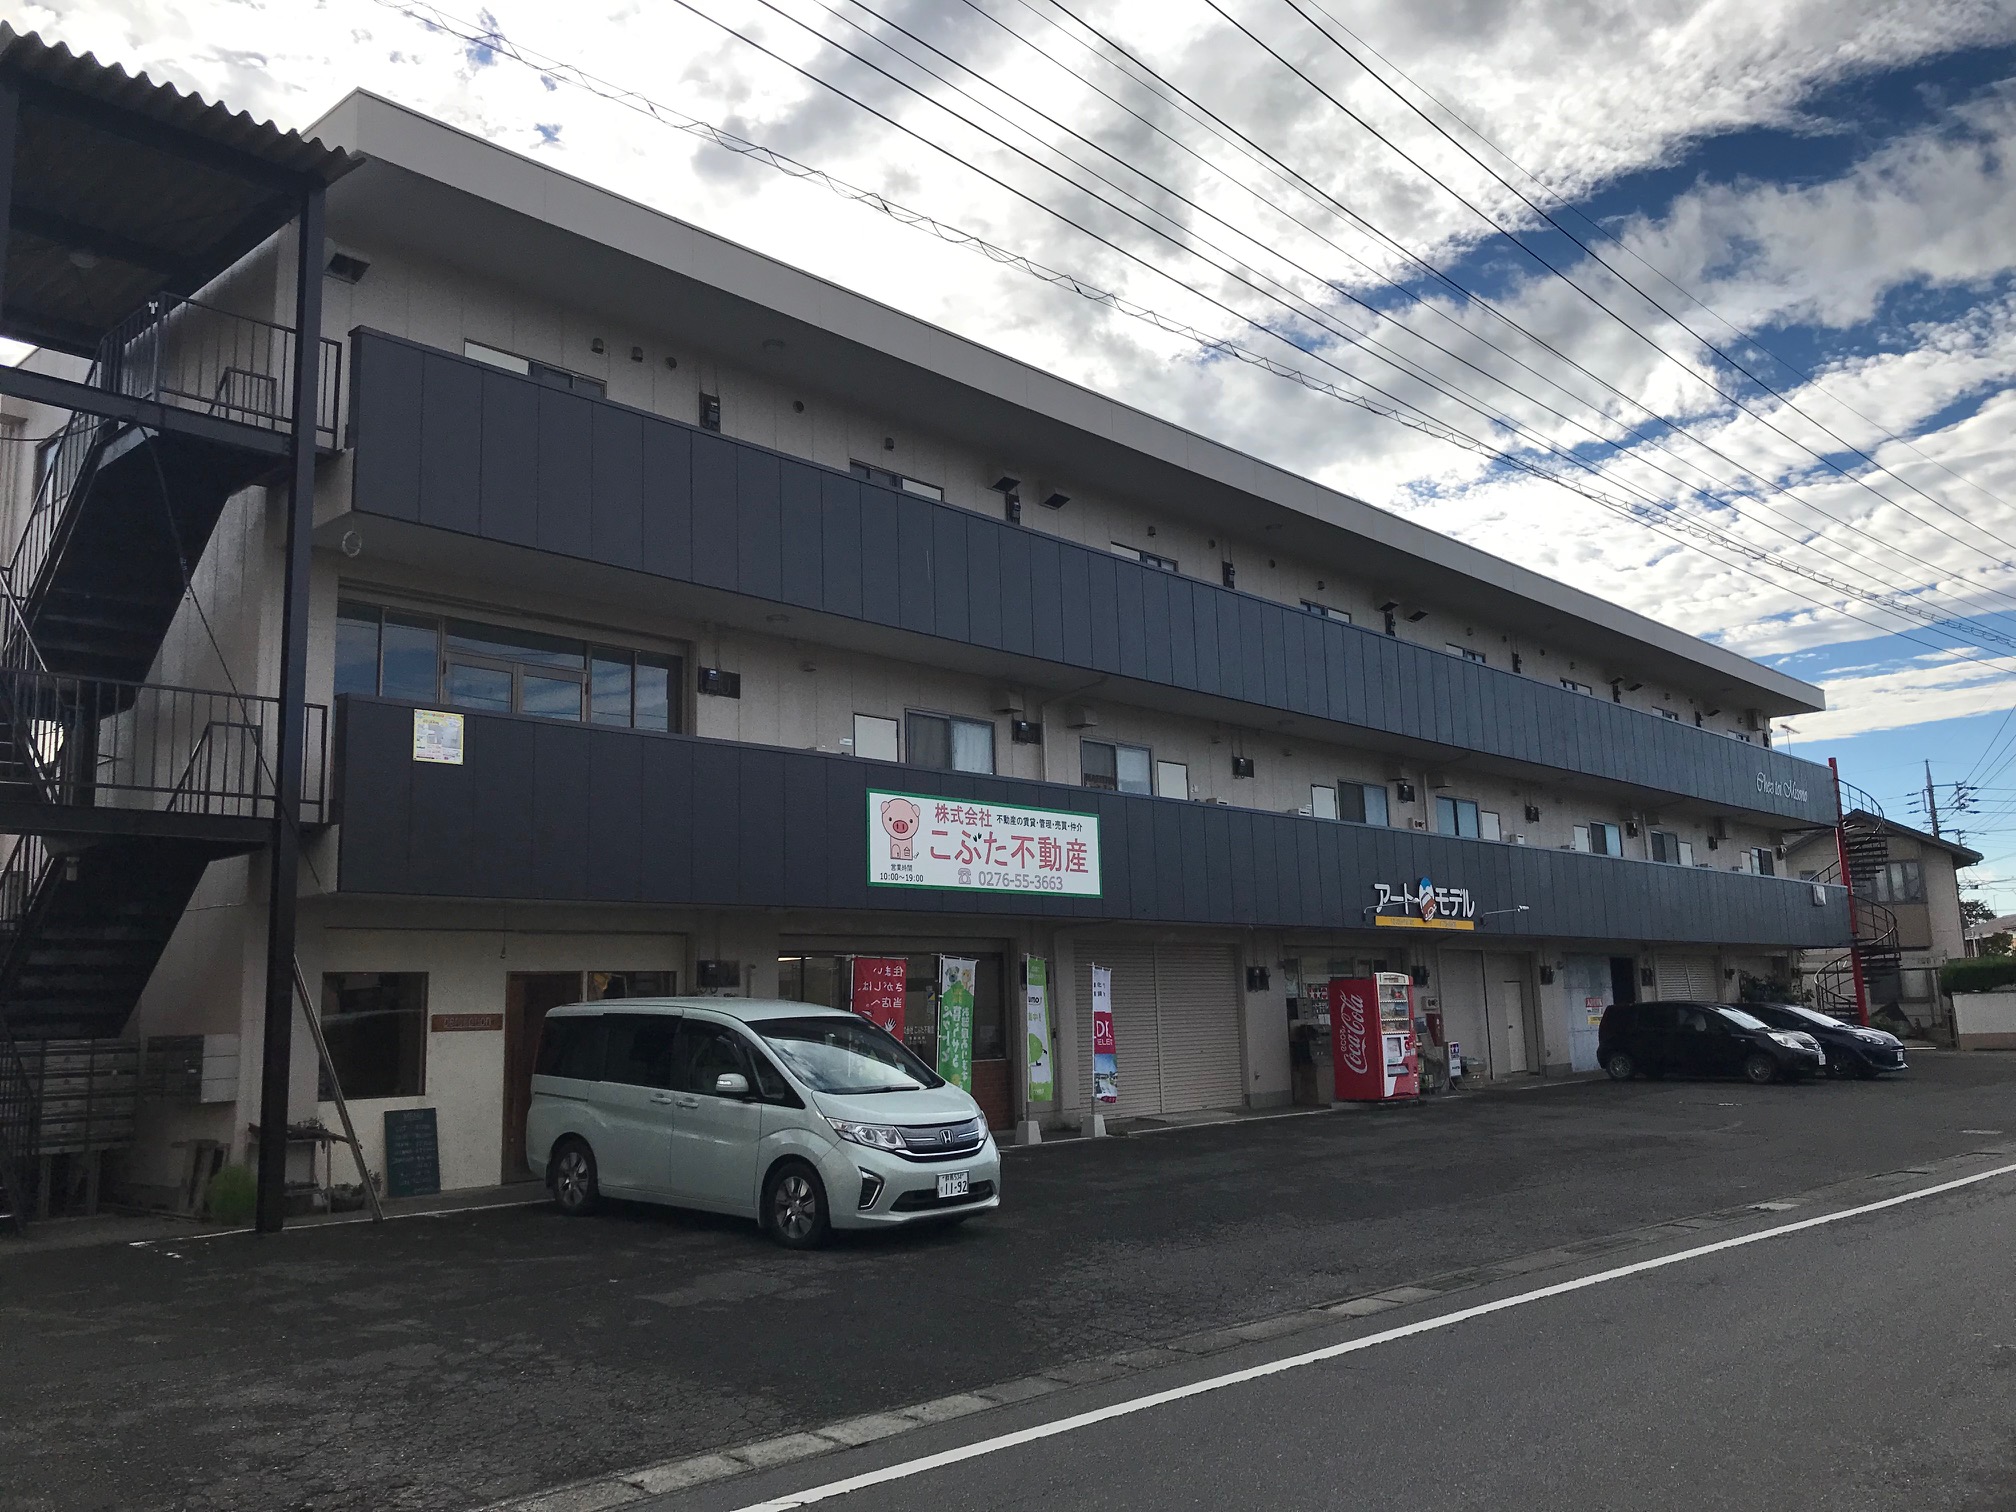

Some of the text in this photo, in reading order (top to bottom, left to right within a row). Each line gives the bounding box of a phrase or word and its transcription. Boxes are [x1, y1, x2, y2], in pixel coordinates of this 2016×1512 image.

[934, 802, 993, 828] 株式会社
[930, 829, 1089, 874] こぶた不動産
[890, 863, 913, 872] 営業時間
[978, 871, 1064, 891] 0276-55-3663
[1435, 887, 1475, 918] モデル
[1340, 989, 1368, 1074] Coca-Cola
